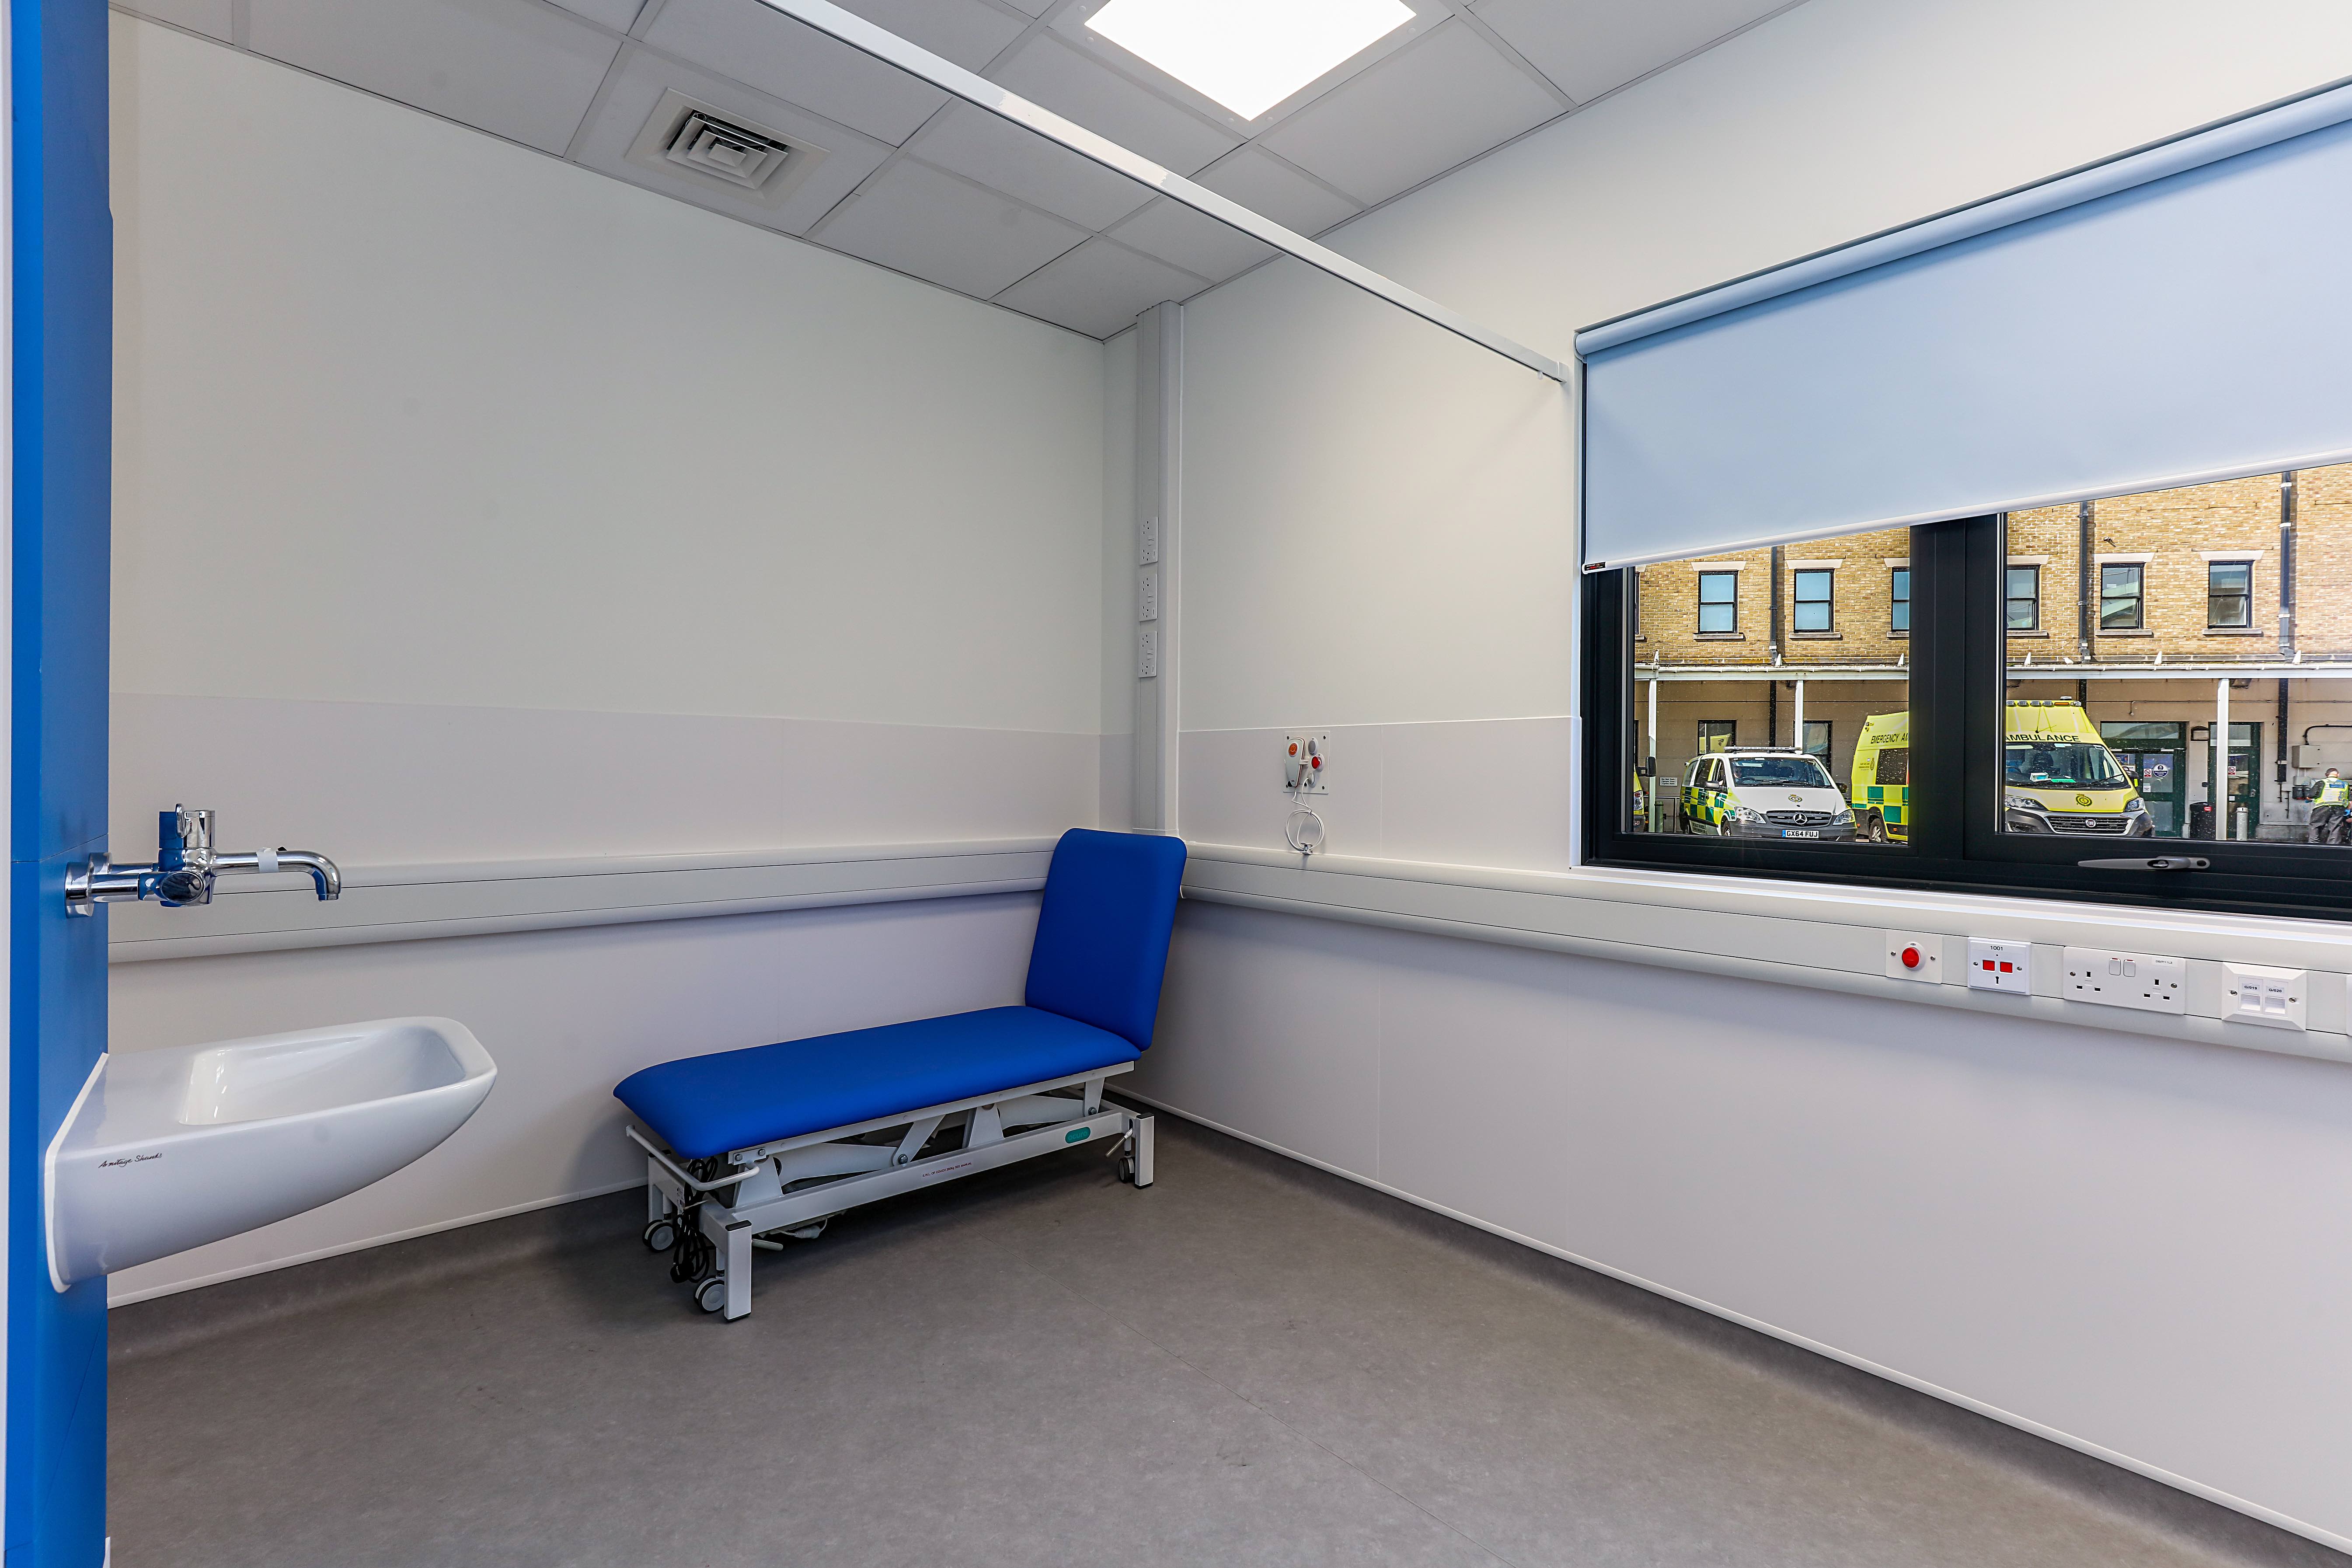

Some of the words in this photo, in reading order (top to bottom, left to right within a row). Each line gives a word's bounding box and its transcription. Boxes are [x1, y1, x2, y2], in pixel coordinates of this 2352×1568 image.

[1871, 733, 1900, 744] EMERGENCY
[1068, 1131, 1087, 1141] acura
[98, 1158, 133, 1168] Armitage
[135, 1153, 162, 1162] Shanks
